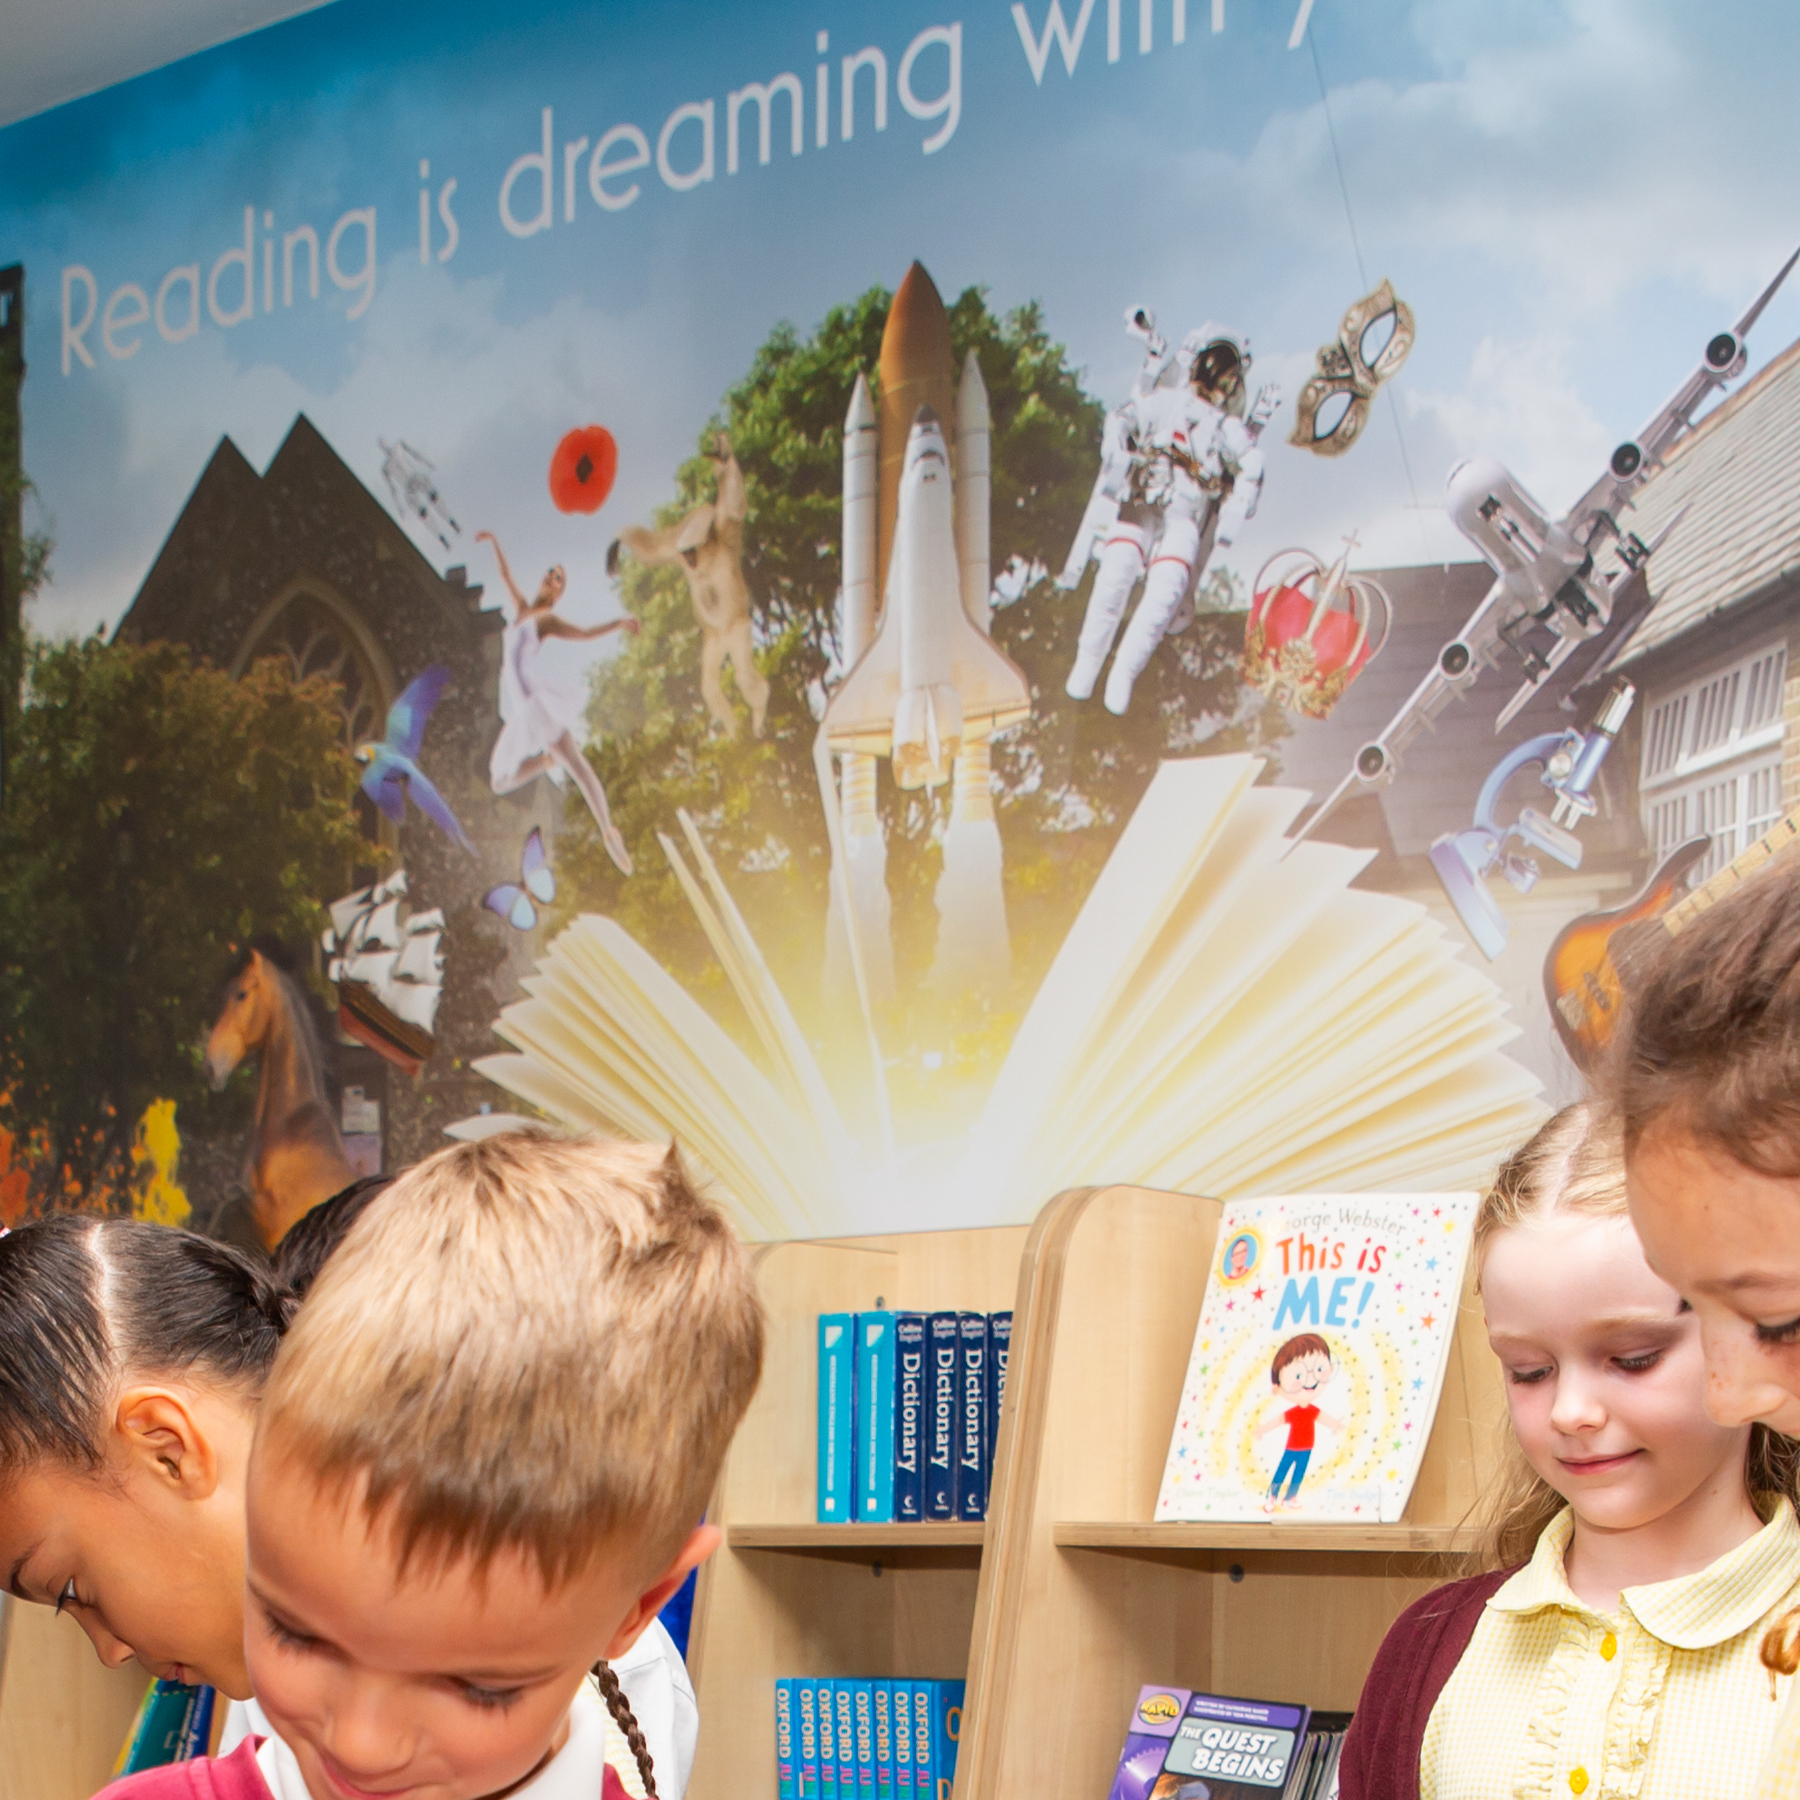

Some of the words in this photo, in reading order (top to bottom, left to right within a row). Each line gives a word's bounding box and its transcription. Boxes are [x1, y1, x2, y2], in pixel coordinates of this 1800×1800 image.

[57, 202, 378, 376] Reading
[417, 160, 458, 267] is
[498, 20, 964, 239] dreaming
[1276, 1232, 1346, 1276] This
[1357, 1237, 1388, 1275] is
[1338, 1207, 1407, 1238] Webster
[1272, 1275, 1376, 1332] ME!
[897, 1352, 921, 1474] Dictionary
[930, 1348, 955, 1470] Dictionary
[960, 1348, 983, 1472] Dictionary
[777, 1688, 792, 1759] OXFORD
[800, 1688, 816, 1760] OXFORD
[818, 1688, 834, 1760] OXFORD
[836, 1690, 853, 1763] OXFORD
[855, 1691, 871, 1763] OXFORD
[875, 1690, 890, 1763] OXFORD
[894, 1691, 911, 1764] OXFORD
[914, 1692, 930, 1765] OXFORD
[1139, 1700, 1180, 1718] RAPID
[1180, 1725, 1203, 1741] THE
[1201, 1727, 1278, 1756] QUEST
[1191, 1748, 1285, 1782] BEGINS
